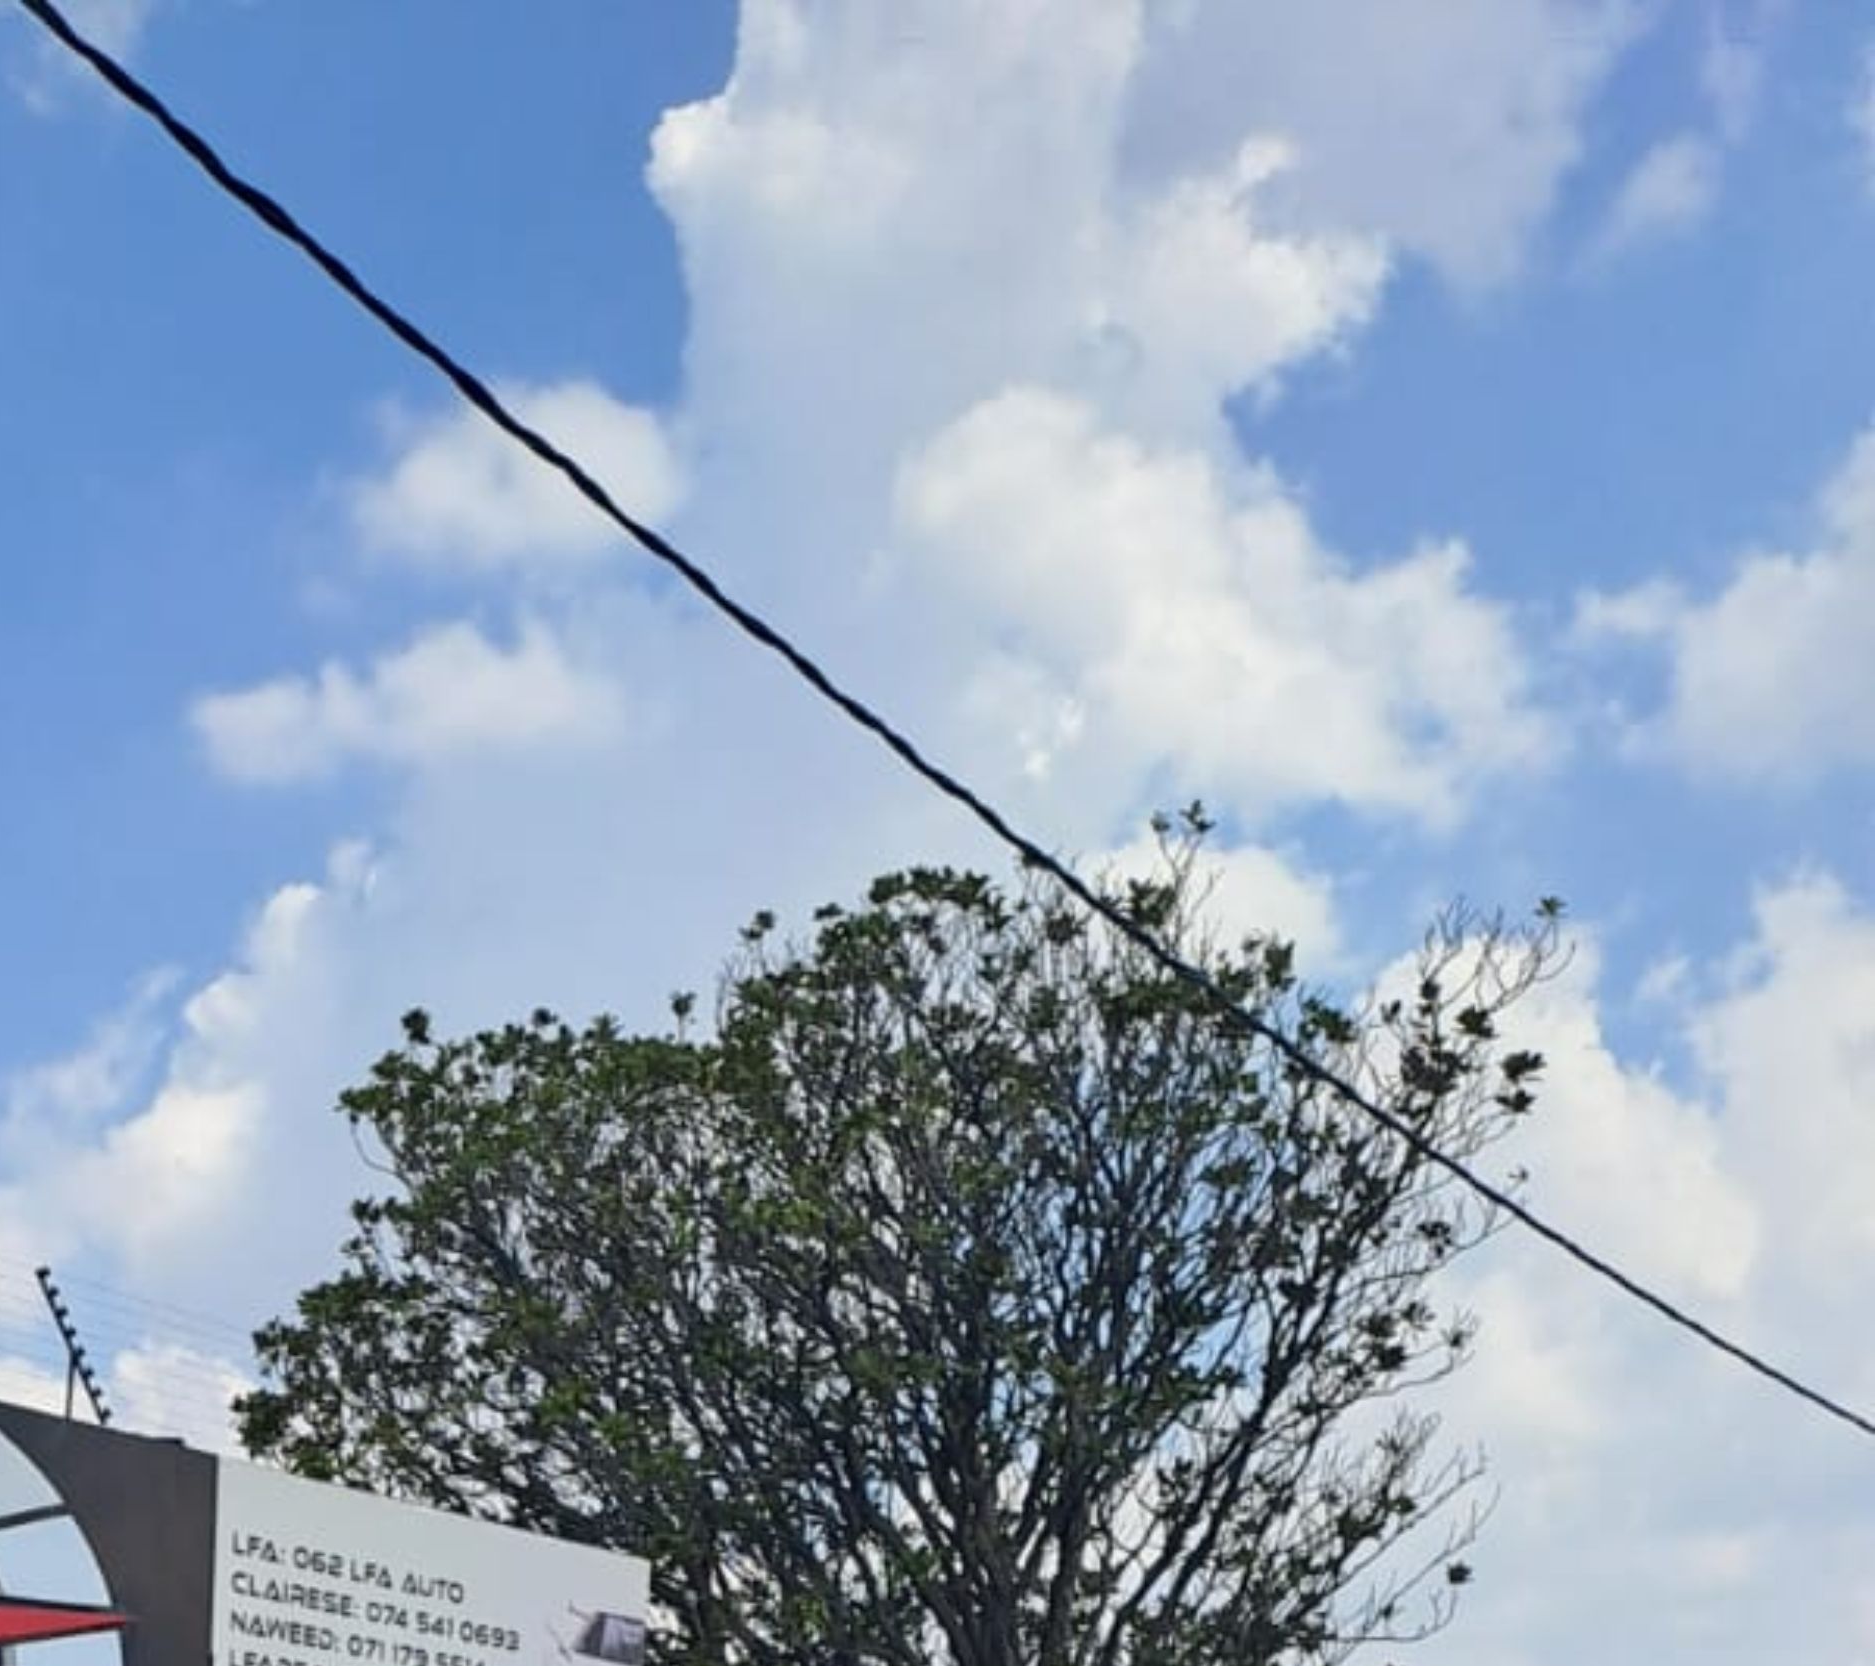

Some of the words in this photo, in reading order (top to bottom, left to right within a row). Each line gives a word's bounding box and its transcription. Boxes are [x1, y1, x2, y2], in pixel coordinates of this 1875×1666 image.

[232, 1530, 286, 1565] LFA:
[293, 1545, 343, 1578] 062
[350, 1558, 393, 1589] LFA
[401, 1573, 465, 1604] AUTO
[230, 1610, 341, 1654] NAWEED:
[346, 1634, 386, 1663] 071
[365, 1601, 409, 1628] 074
[415, 1610, 455, 1640] 541
